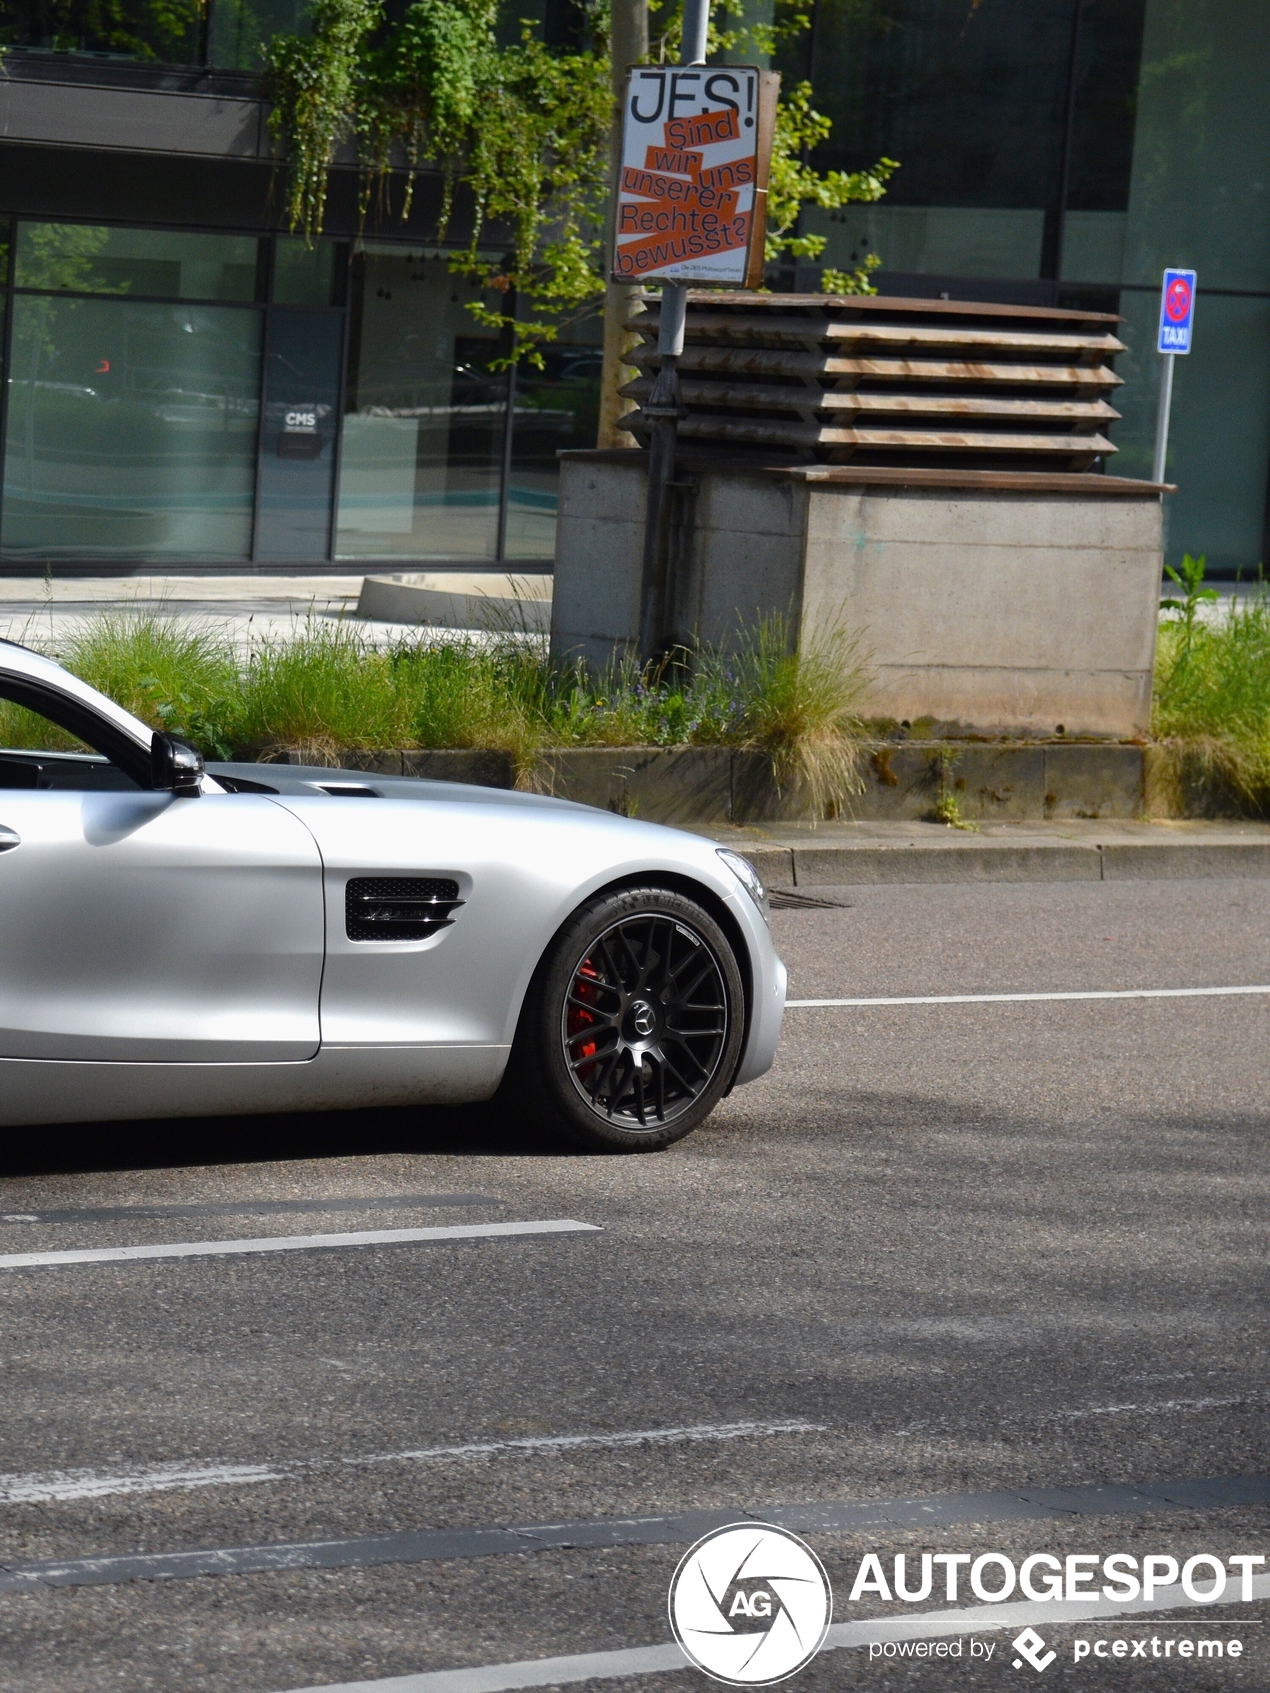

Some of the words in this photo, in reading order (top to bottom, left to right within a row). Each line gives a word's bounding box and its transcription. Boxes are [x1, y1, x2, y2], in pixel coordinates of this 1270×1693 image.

[630, 72, 755, 127] JES!
[668, 110, 734, 149] Sind
[654, 149, 698, 173] wir
[698, 161, 752, 190] uns
[624, 171, 732, 210] unserer
[620, 203, 719, 233] Rechte
[616, 216, 747, 275] bewusst?
[1163, 326, 1188, 345] TAXI
[285, 412, 316, 426] CMS
